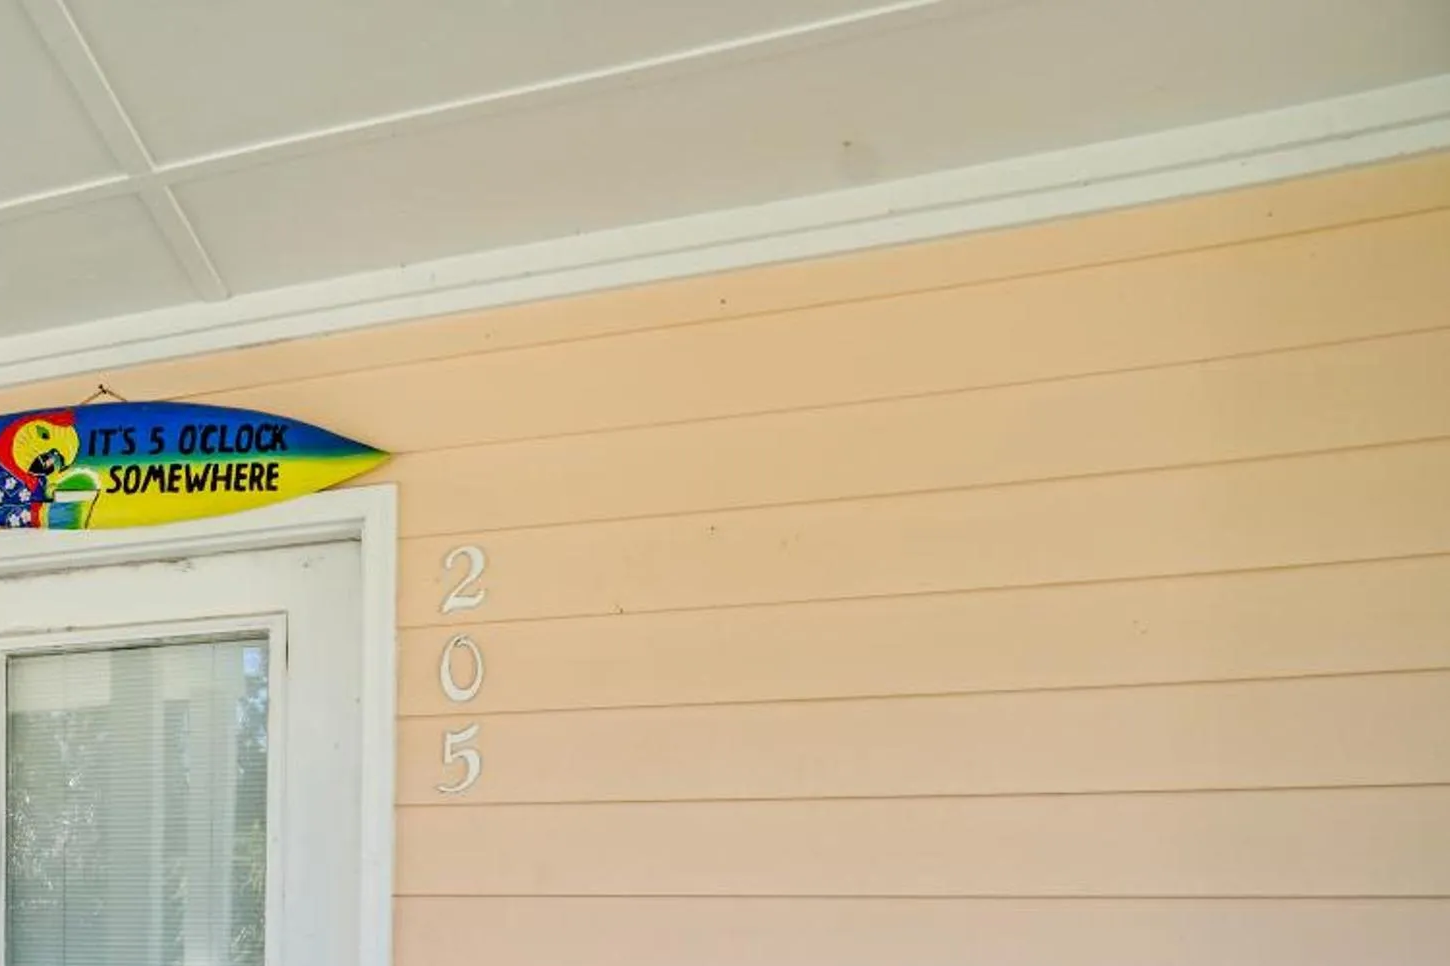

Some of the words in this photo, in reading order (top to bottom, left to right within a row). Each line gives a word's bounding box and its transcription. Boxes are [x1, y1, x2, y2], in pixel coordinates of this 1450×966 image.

[87, 424, 137, 457] IT'S
[149, 425, 166, 455] 5
[178, 423, 289, 456] O'CLOCK
[105, 462, 280, 495] SOMEWHERE
